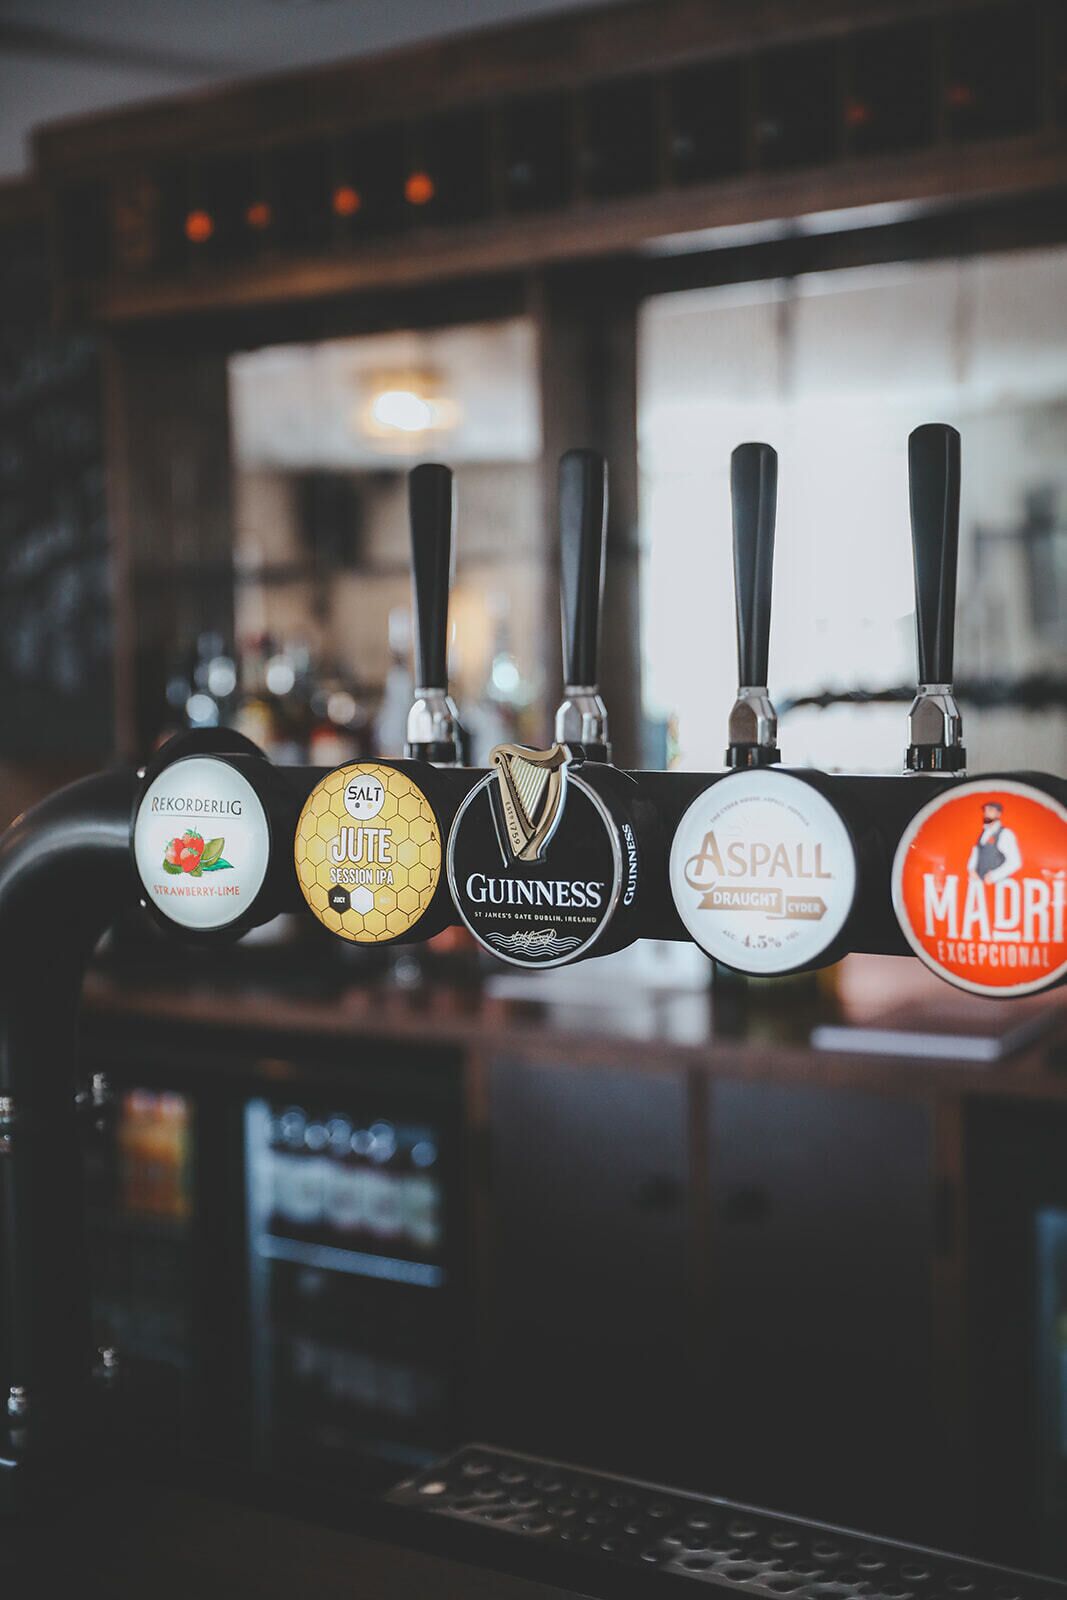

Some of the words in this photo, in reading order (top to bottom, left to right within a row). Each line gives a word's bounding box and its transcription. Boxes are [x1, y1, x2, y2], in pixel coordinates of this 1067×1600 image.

[347, 786, 381, 801] SALT
[151, 796, 242, 816] REKORDERLIG
[509, 821, 521, 845] 1759
[332, 826, 392, 863] JUTE
[621, 823, 638, 906] GUINNESS
[684, 830, 832, 891] ASPALL
[329, 867, 374, 885] SESSION
[375, 869, 394, 885] IPA
[153, 884, 240, 897] STRAWBERRY-LIME
[465, 873, 601, 908] GUINNESS
[713, 892, 778, 907] DRAUGHT
[474, 911, 483, 919] ST
[484, 911, 512, 919] JAMES'S
[514, 913, 532, 921] GATE
[565, 916, 597, 924] IRELAND
[788, 904, 821, 914] CYDER
[937, 940, 1050, 968] EXCEPCIONAL
